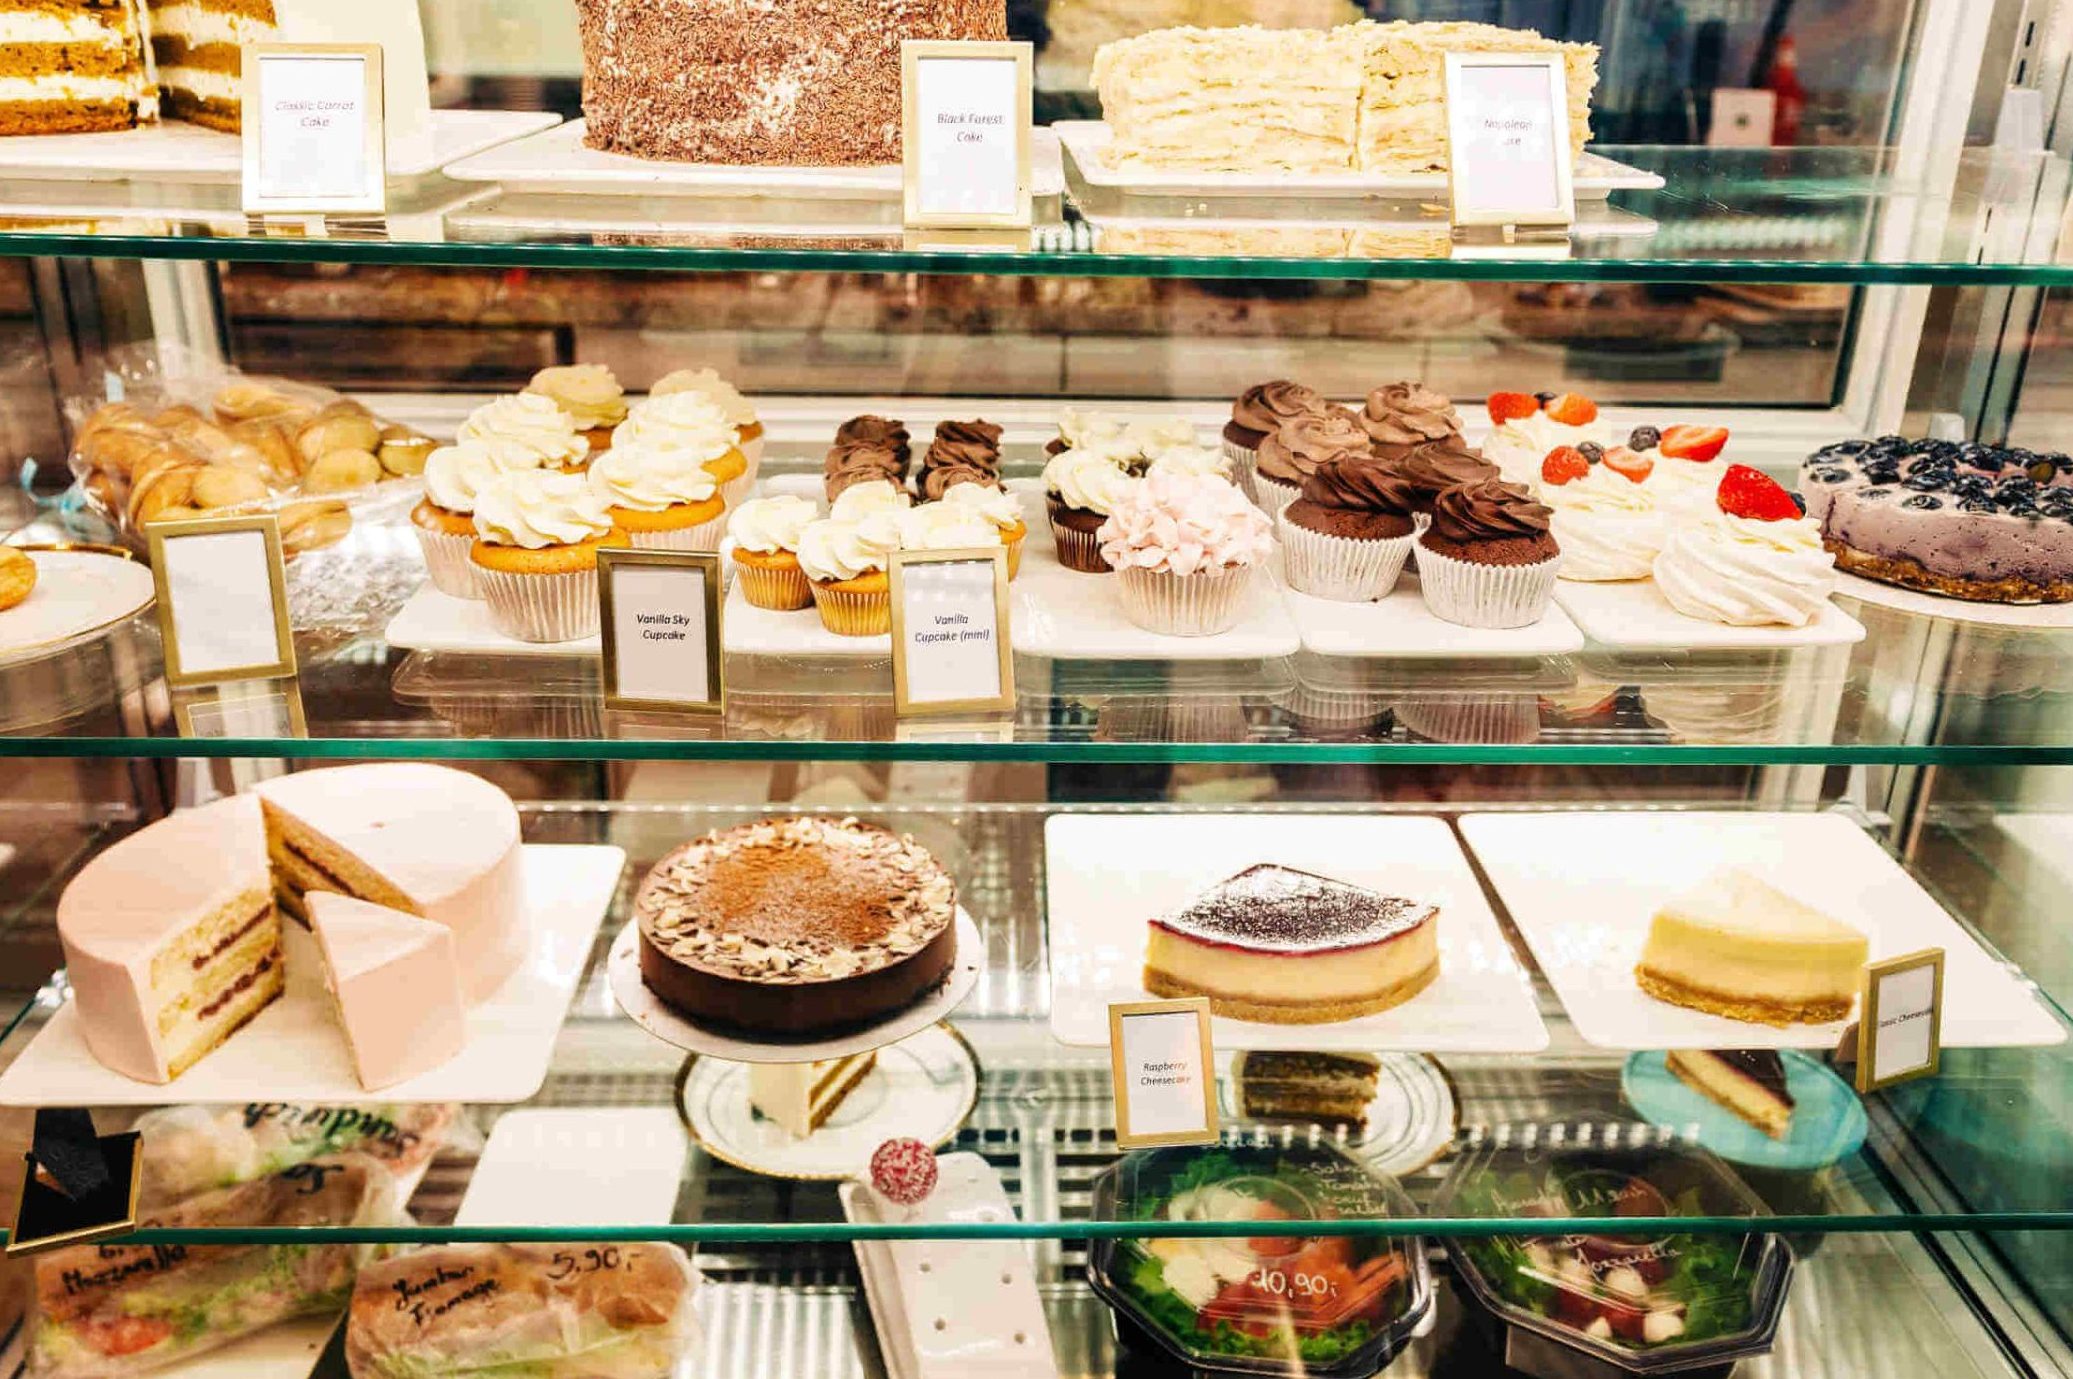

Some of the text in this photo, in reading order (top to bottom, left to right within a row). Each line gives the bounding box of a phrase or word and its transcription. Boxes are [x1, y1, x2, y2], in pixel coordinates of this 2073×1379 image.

[937, 112, 1004, 125] Black Forest
[636, 614, 690, 627] Vanilla Sky
[934, 612, 969, 625] Vanilla
[642, 629, 686, 642] Cupcake
[914, 630, 958, 644] Cupcake
[1143, 1061, 1188, 1074] Raspberry
